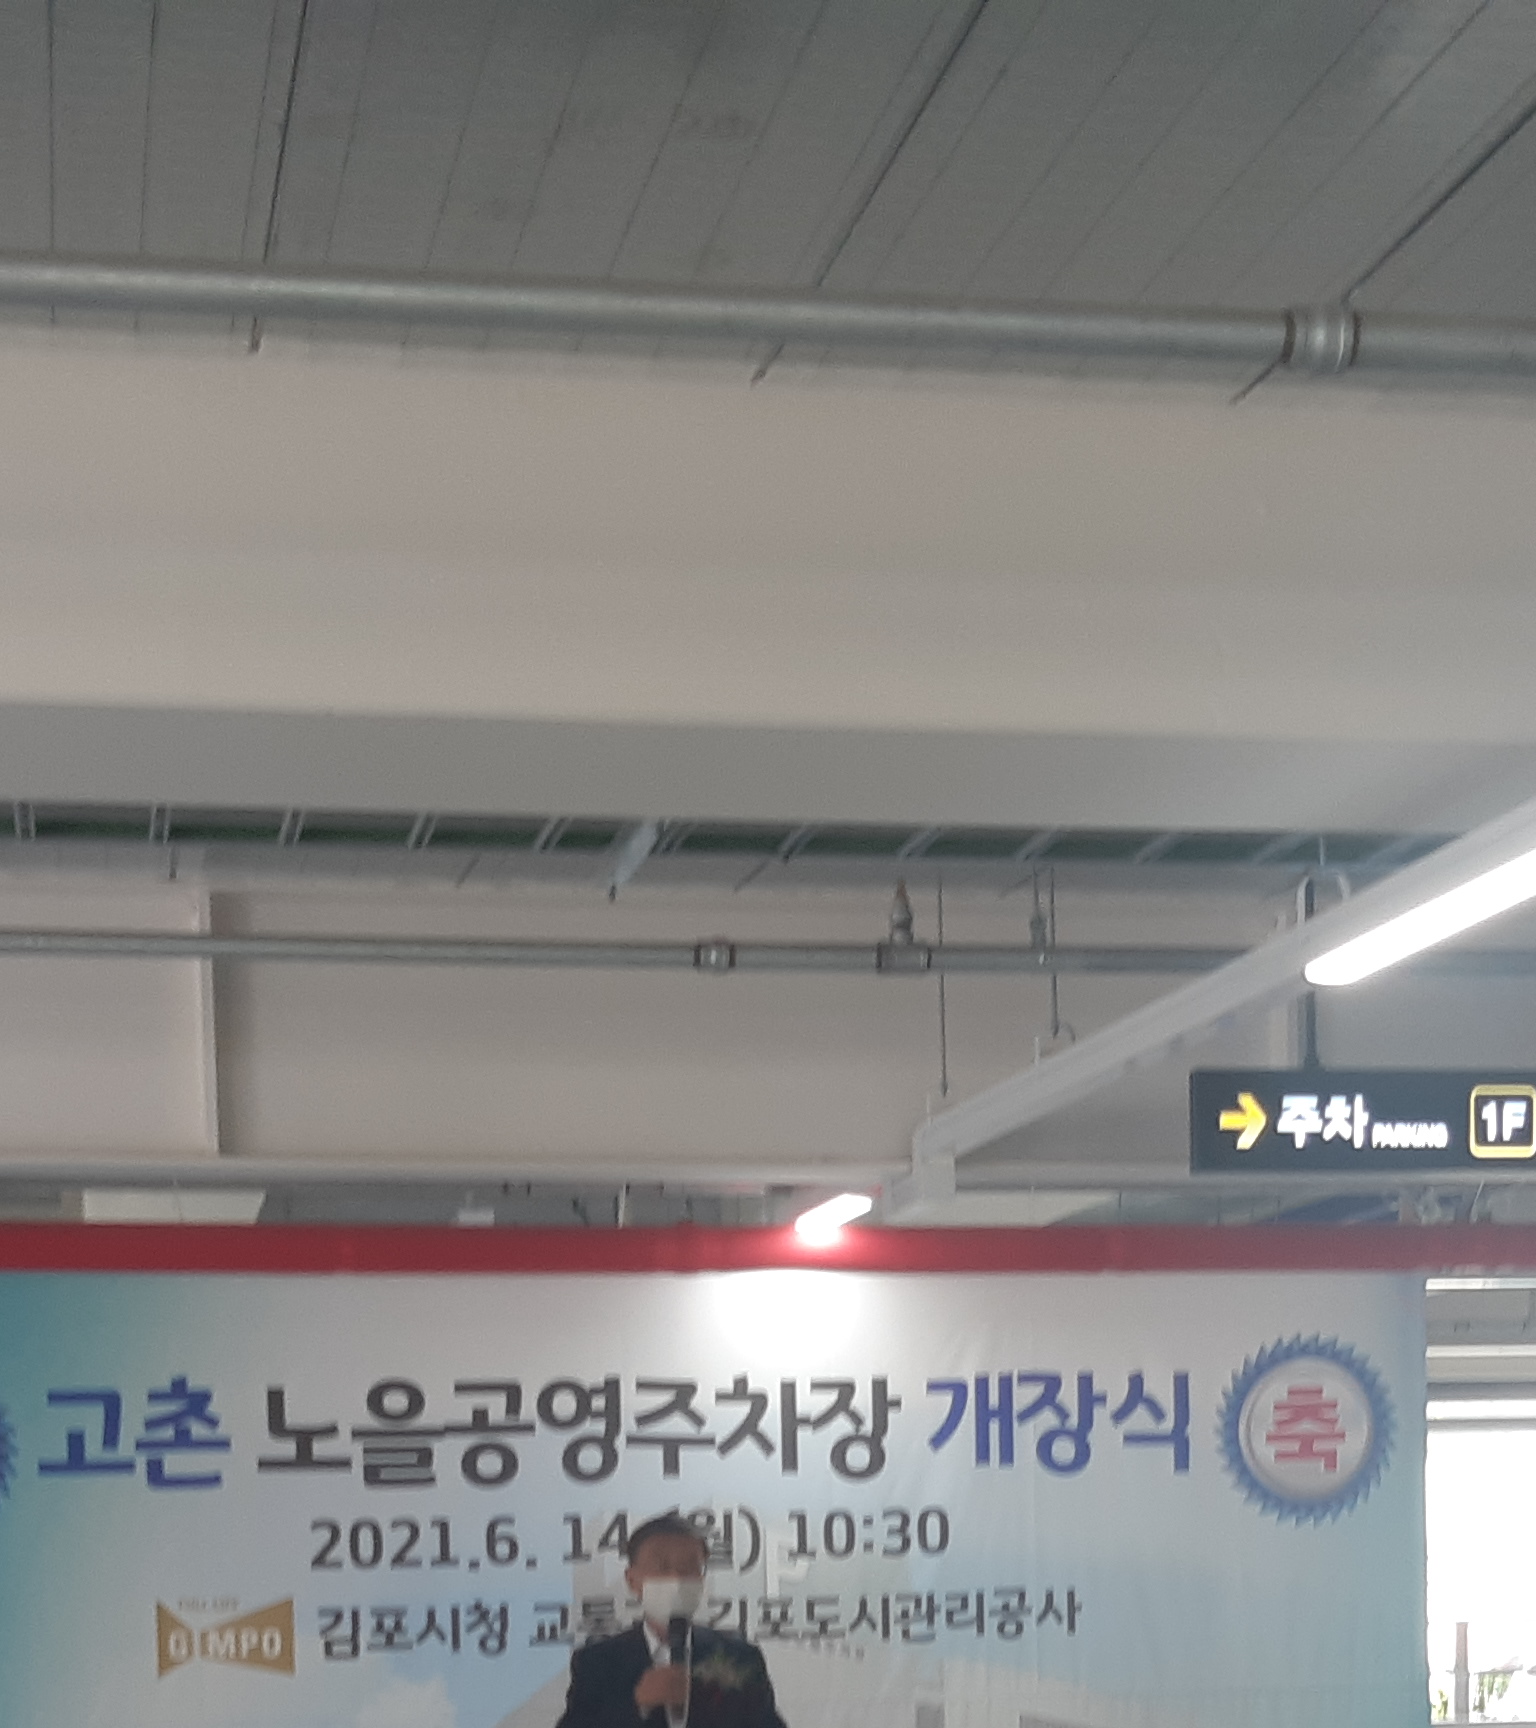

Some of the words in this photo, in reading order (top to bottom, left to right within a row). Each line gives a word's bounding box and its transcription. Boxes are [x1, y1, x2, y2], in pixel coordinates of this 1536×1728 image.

[1277, 1094, 1369, 1149] 주차
[1481, 1101, 1526, 1143] 1F
[37, 1373, 232, 1490] 고촌
[256, 1374, 902, 1488] 노을공영주차장
[925, 1370, 1191, 1475] 개장식
[1266, 1384, 1346, 1473] 축
[786, 1507, 951, 1560] 10:30
[317, 1599, 510, 1660] 김포시청
